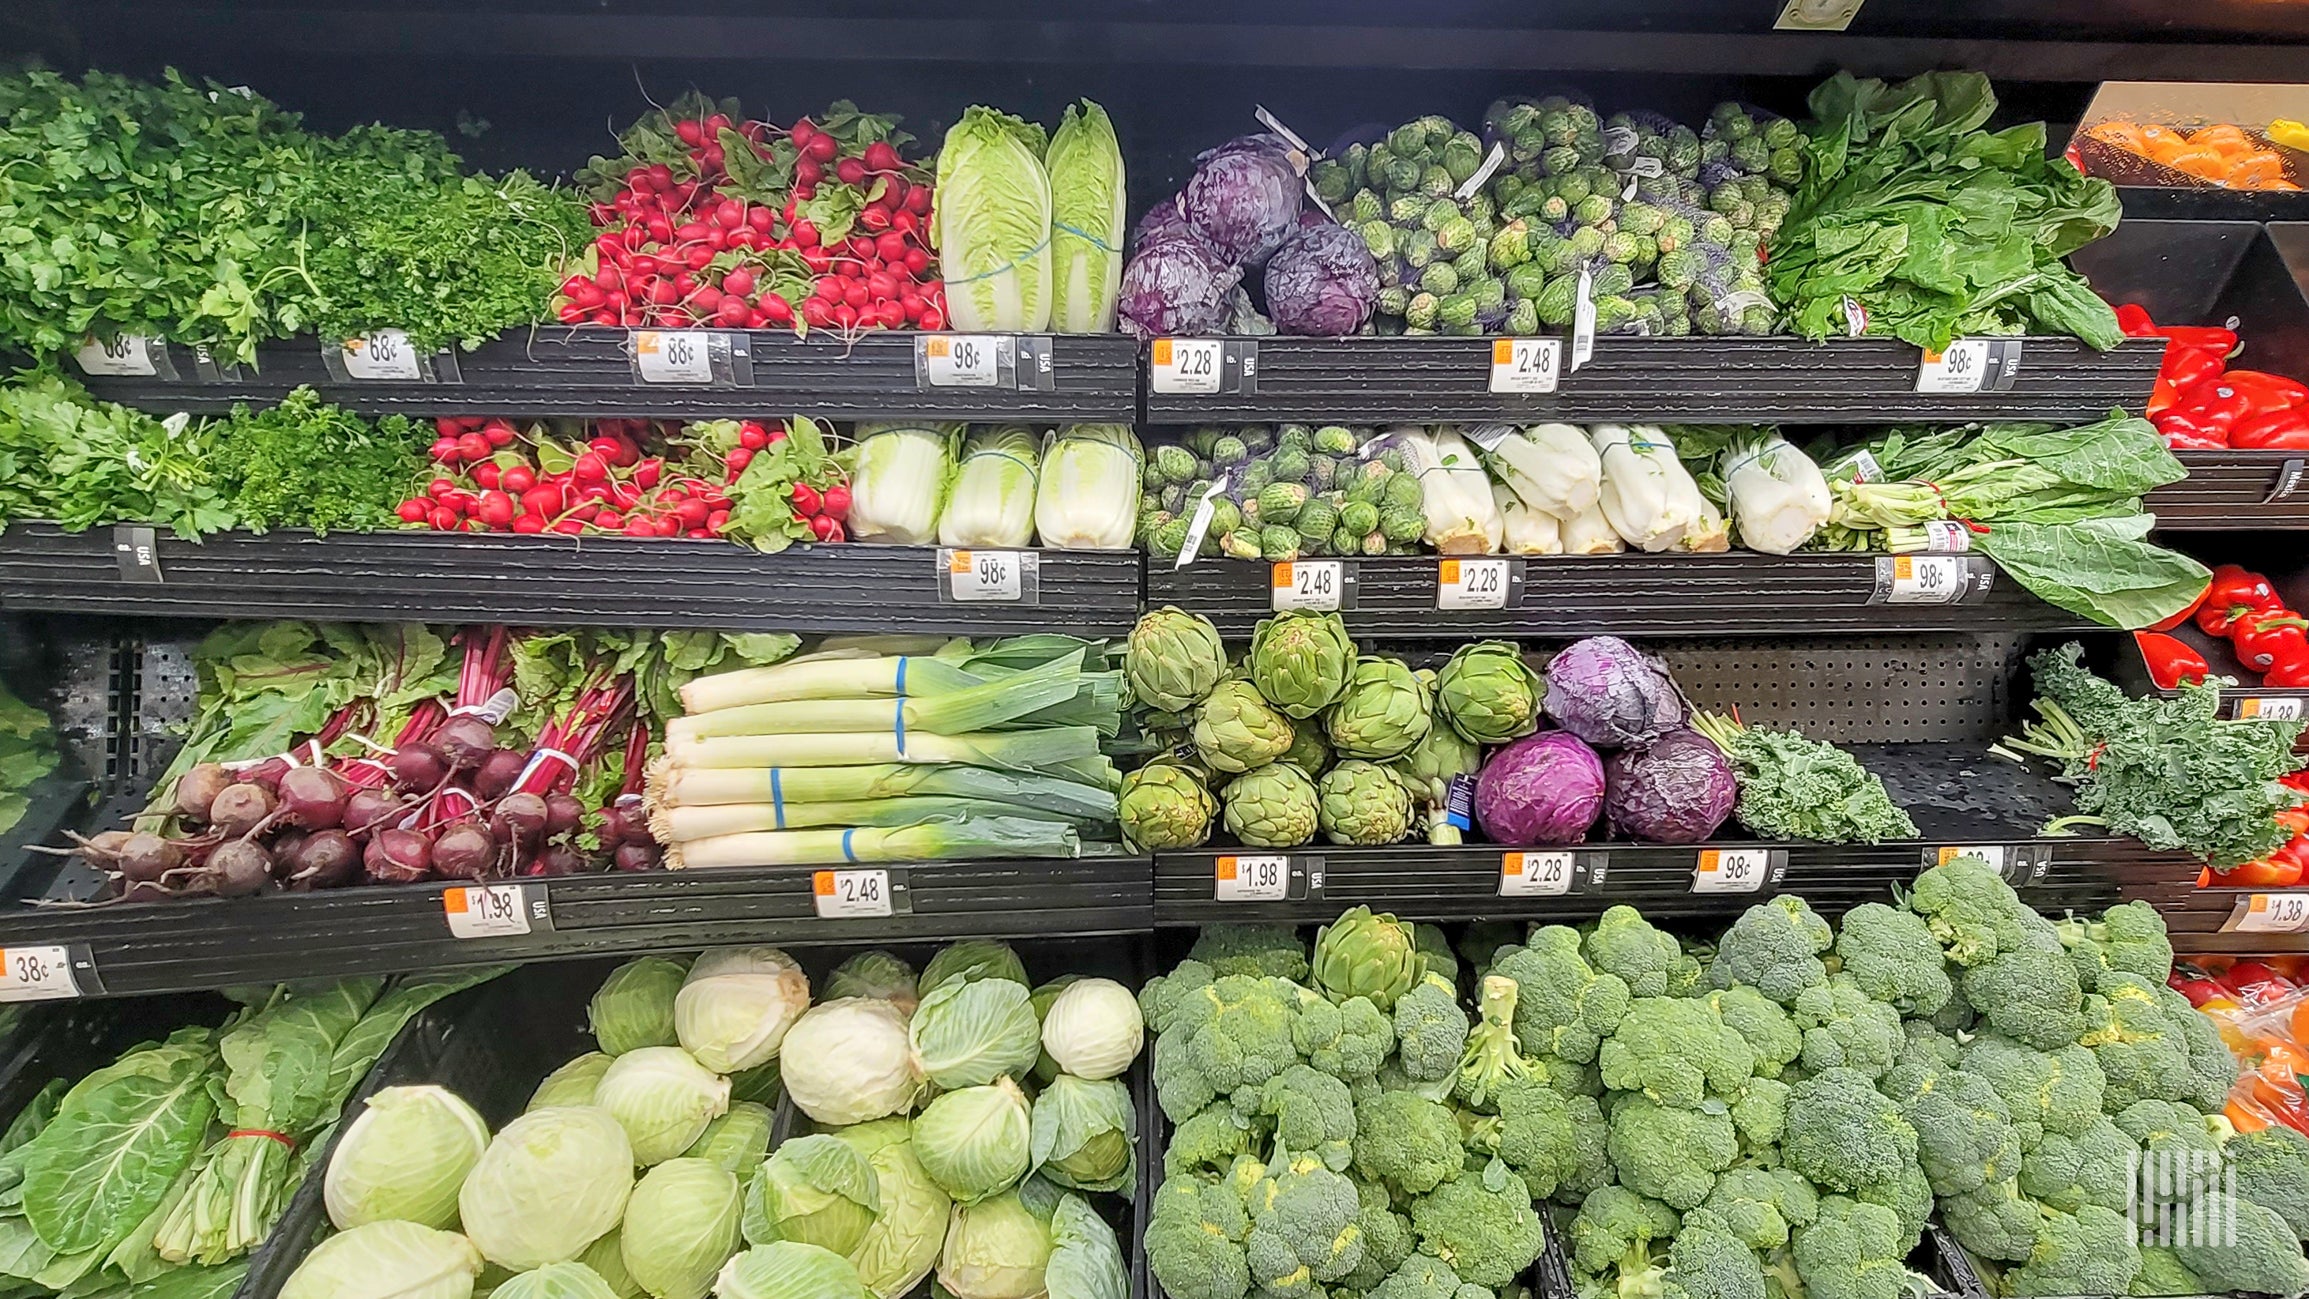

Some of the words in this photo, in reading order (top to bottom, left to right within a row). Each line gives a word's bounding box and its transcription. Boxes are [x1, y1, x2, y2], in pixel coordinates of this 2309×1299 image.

[196, 344, 210, 364] USA
[369, 334, 398, 362] 68¢
[667, 337, 695, 365] 88¢
[953, 342, 981, 369] 98¢
[1226, 355, 1237, 364] lb.
[1516, 347, 1550, 373] $2.48
[1038, 353, 1052, 373] USA
[1176, 349, 1212, 375] $2.28
[1243, 357, 1255, 377] USA
[1948, 348, 1972, 374] 98¢
[2003, 358, 2018, 377] USA
[2277, 471, 2303, 499] Mexico
[136, 546, 152, 566] USA
[979, 558, 1007, 585] 98¢
[1296, 569, 1332, 595] $2.48
[1464, 567, 1498, 593] $2.28
[1919, 564, 1944, 589] 98¢
[1977, 573, 1992, 591] USA
[1241, 862, 1278, 887] $1.98
[1527, 858, 1562, 882] $2.28
[1591, 868, 1606, 885] USA
[1725, 855, 1751, 879] 98¢
[1769, 868, 1785, 883] USA
[2034, 860, 2048, 877] USA
[840, 877, 879, 902] $2.48
[1310, 872, 1323, 890] USA
[471, 892, 513, 920] $1.98
[531, 901, 548, 920] USA
[2271, 899, 2303, 922] $1.38
[16, 955, 49, 983] 38¢
